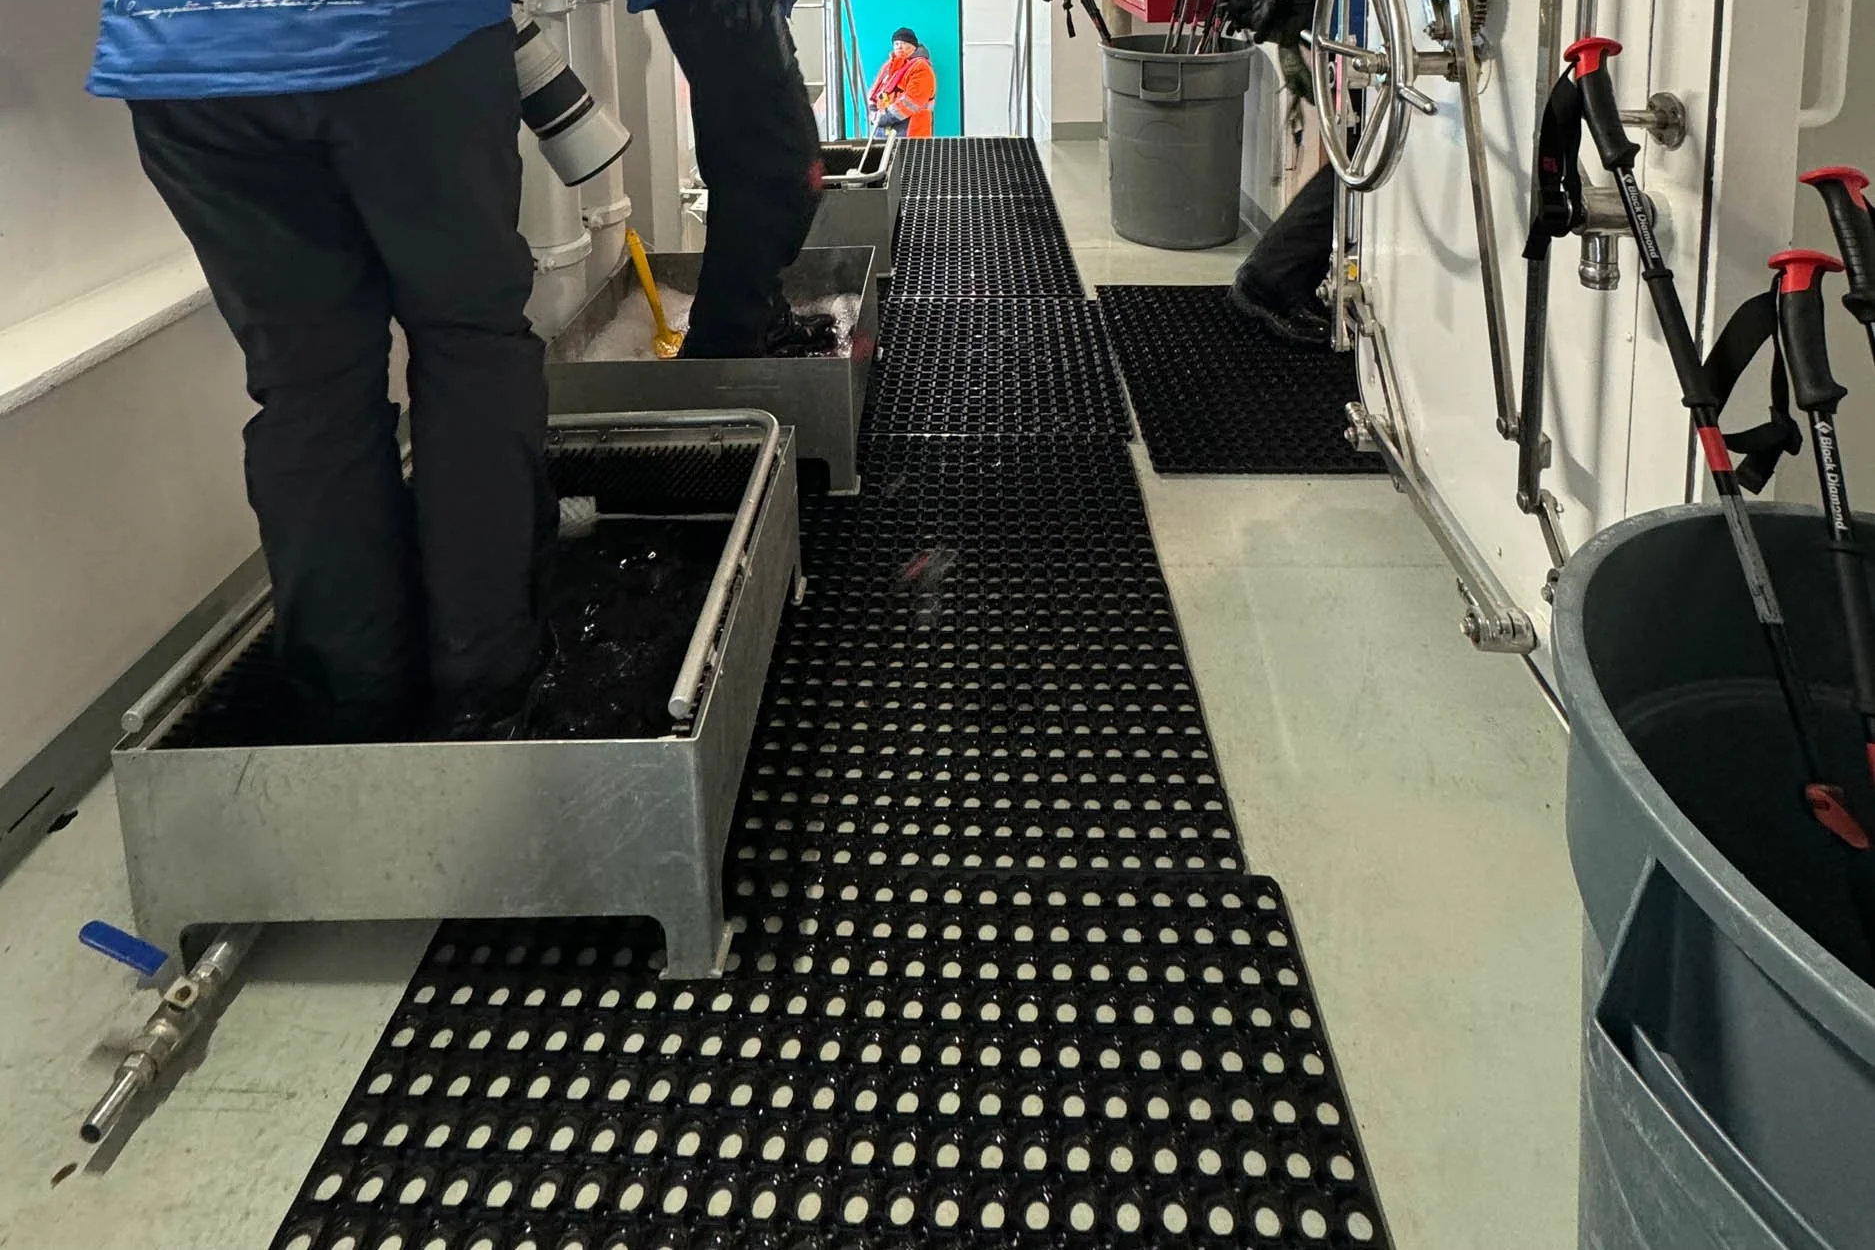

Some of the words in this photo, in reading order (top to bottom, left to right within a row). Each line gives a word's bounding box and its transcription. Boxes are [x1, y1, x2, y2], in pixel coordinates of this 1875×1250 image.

[1627, 185, 1643, 213] Black
[1637, 213, 1659, 259] Diamond
[1820, 435, 1837, 473] Black
[1827, 473, 1848, 531] Diamond
